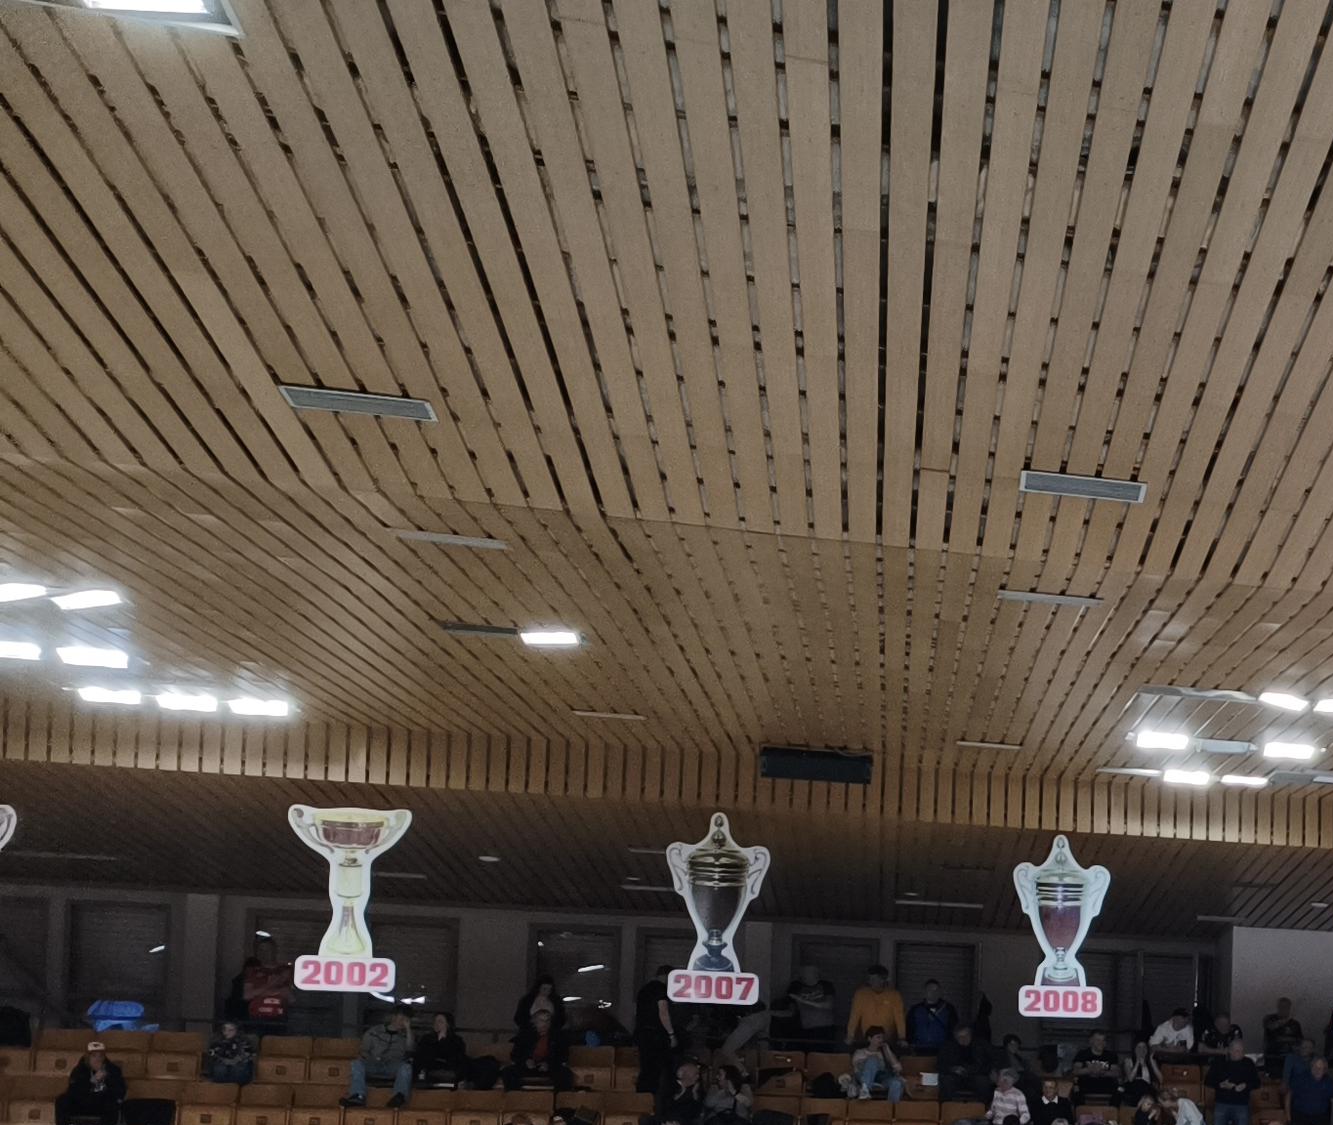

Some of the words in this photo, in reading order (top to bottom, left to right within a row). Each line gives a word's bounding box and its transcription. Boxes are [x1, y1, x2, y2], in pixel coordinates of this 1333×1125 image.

[301, 960, 388, 987] 2002
[673, 974, 755, 1000] 2007
[1024, 990, 1098, 1013] 2008
